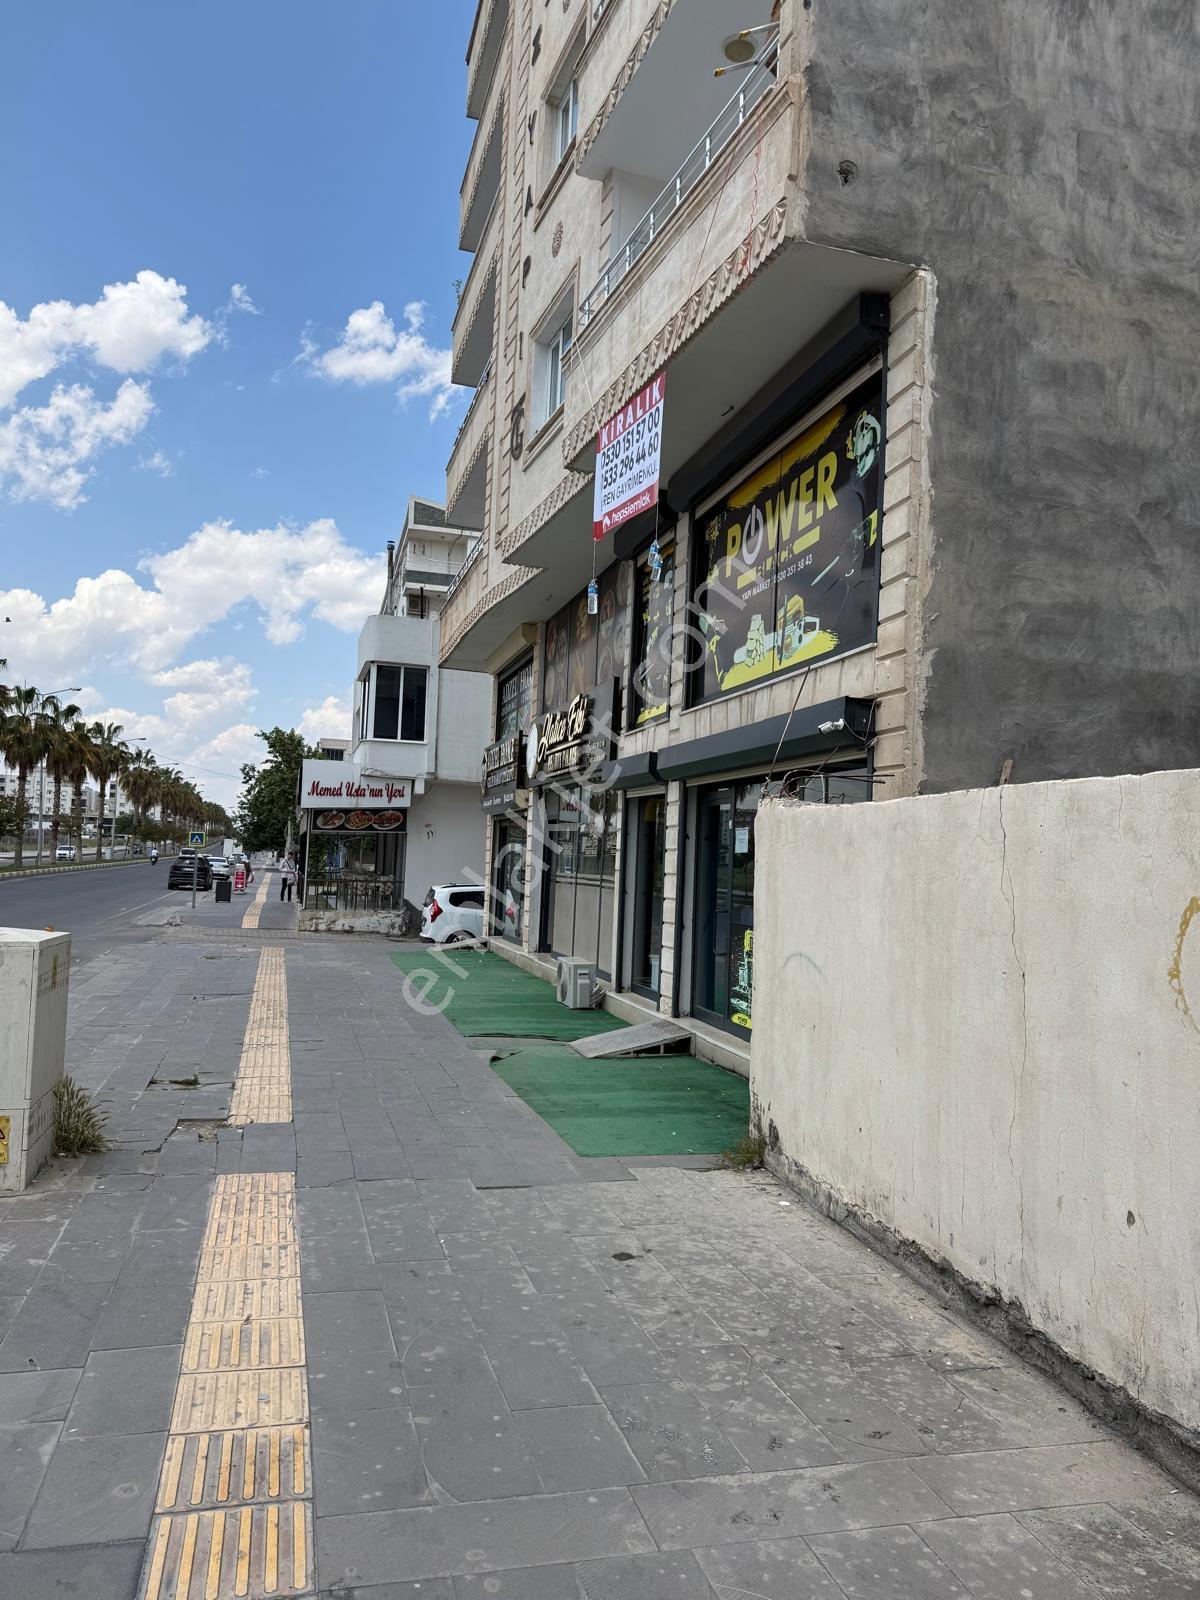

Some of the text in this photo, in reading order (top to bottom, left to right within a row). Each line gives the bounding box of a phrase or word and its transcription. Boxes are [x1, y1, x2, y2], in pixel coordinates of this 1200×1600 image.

[601, 377, 662, 449] KİRALIK
[601, 406, 660, 470] 0530 151 57 00
[602, 432, 659, 490] 533 296 44 60
[726, 452, 839, 578] POWER
[752, 578, 771, 597] MARKET
[307, 780, 343, 797] Memed
[385, 782, 406, 804] Yeri
